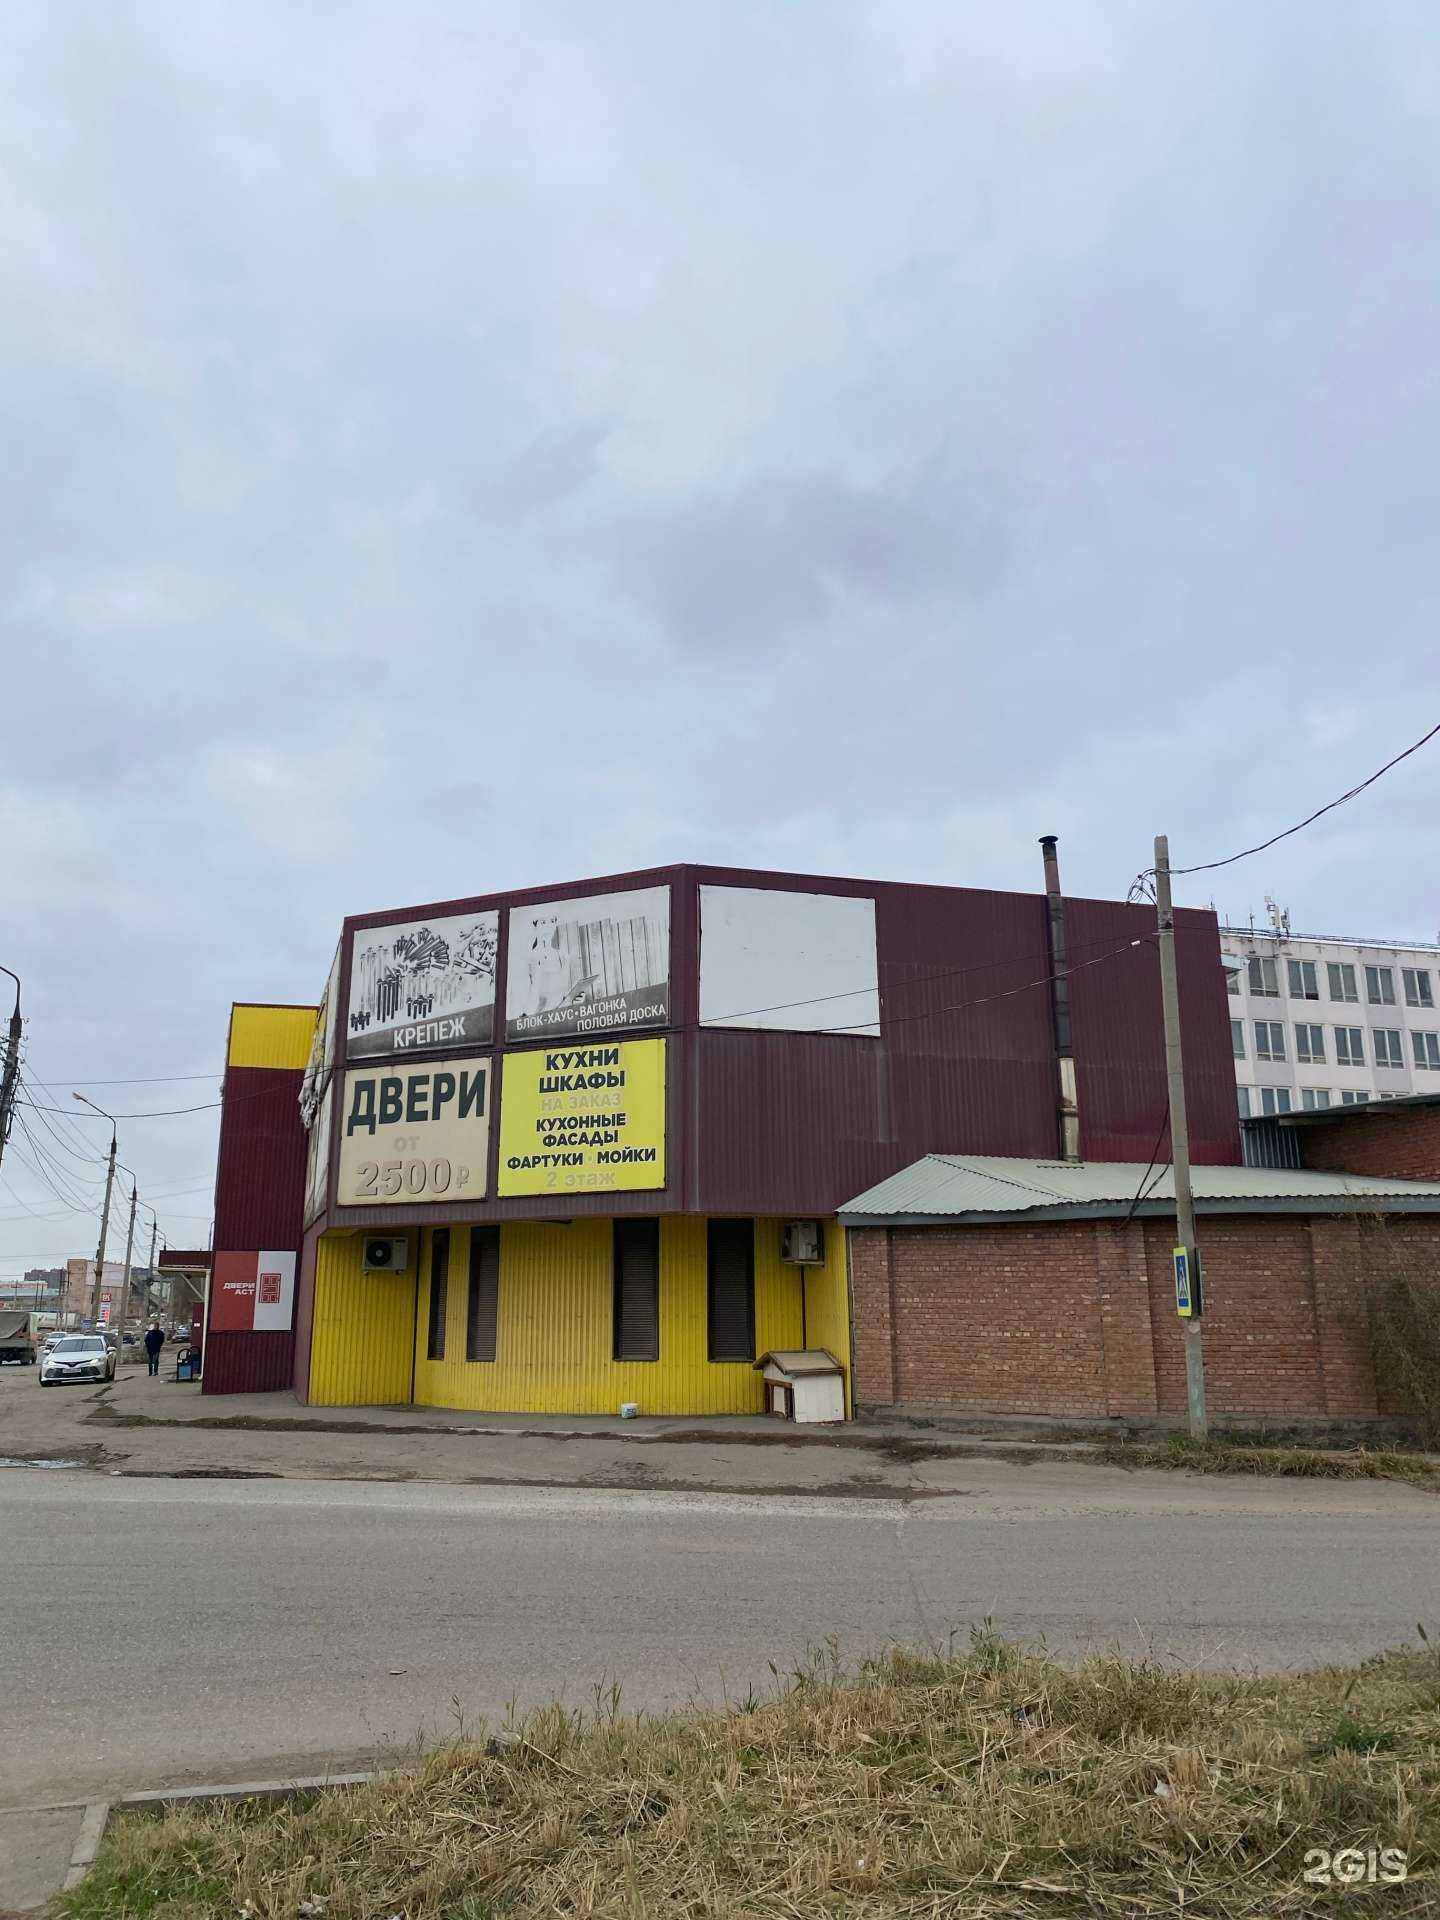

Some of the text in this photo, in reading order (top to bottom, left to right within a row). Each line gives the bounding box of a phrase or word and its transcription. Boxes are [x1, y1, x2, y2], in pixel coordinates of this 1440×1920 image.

[577, 1004, 666, 1032] ПОЛОВАЯ ДОСКА
[393, 1016, 466, 1048] КРЕПЕЖ
[546, 1048, 619, 1071] КУХНИ
[539, 1071, 625, 1093] ШКАФЫ
[347, 1069, 486, 1136] ДВЕРИ
[541, 1092, 622, 1112] НА ЗАКАЗ
[536, 1113, 626, 1132] КУХОННЫЕ
[542, 1130, 618, 1148] ФАСАДЫ
[507, 1147, 656, 1170] ФАРТУКИ МОЙКИ
[546, 1171, 557, 1187] 2
[223, 1282, 255, 1290] ДВЕРИ
